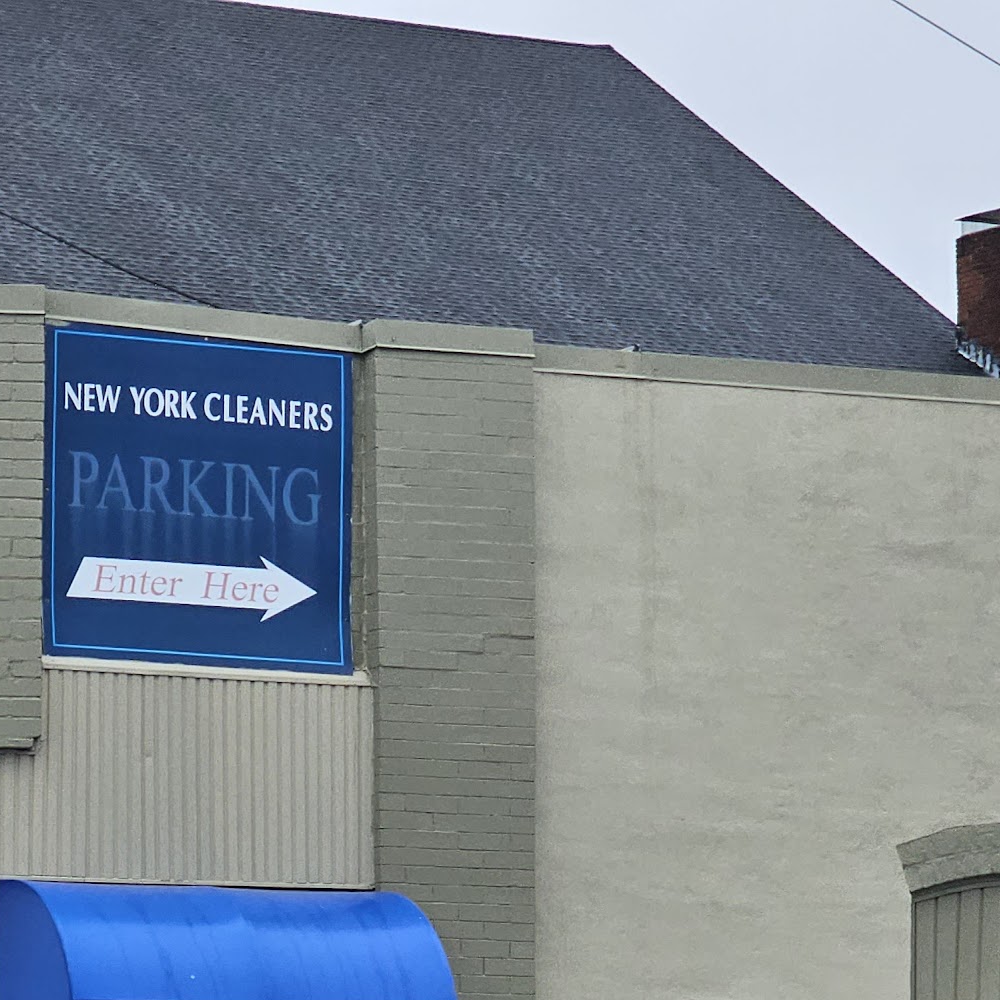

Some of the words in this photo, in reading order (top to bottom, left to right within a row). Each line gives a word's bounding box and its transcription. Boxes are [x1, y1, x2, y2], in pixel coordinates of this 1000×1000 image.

[64, 381, 122, 413] NEW
[129, 386, 197, 420] YORK
[203, 392, 333, 432] CLEANERS
[68, 450, 322, 526] PARKING
[92, 563, 183, 597] Enter
[200, 571, 280, 603] Here
